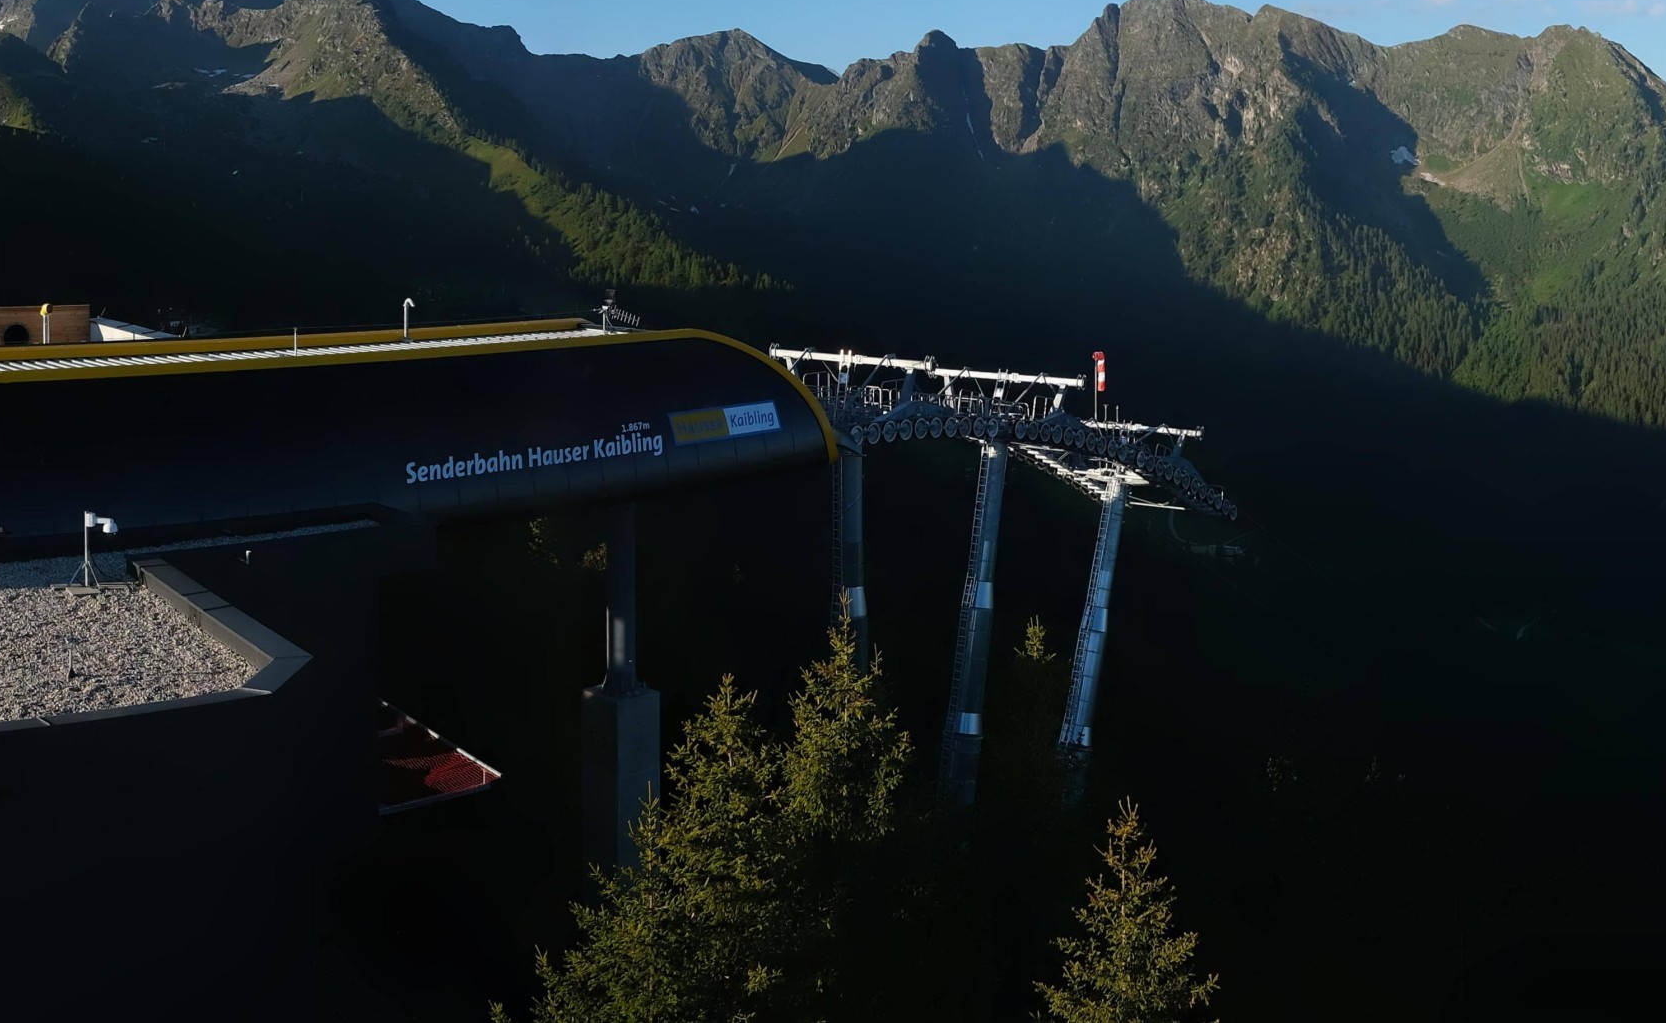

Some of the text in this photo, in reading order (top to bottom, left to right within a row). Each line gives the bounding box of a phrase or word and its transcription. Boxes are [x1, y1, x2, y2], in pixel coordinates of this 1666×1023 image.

[621, 421, 650, 433] 1.867m
[729, 410, 774, 428] Kaibling
[406, 432, 663, 484] Senderbahn Hauser Kaibling
